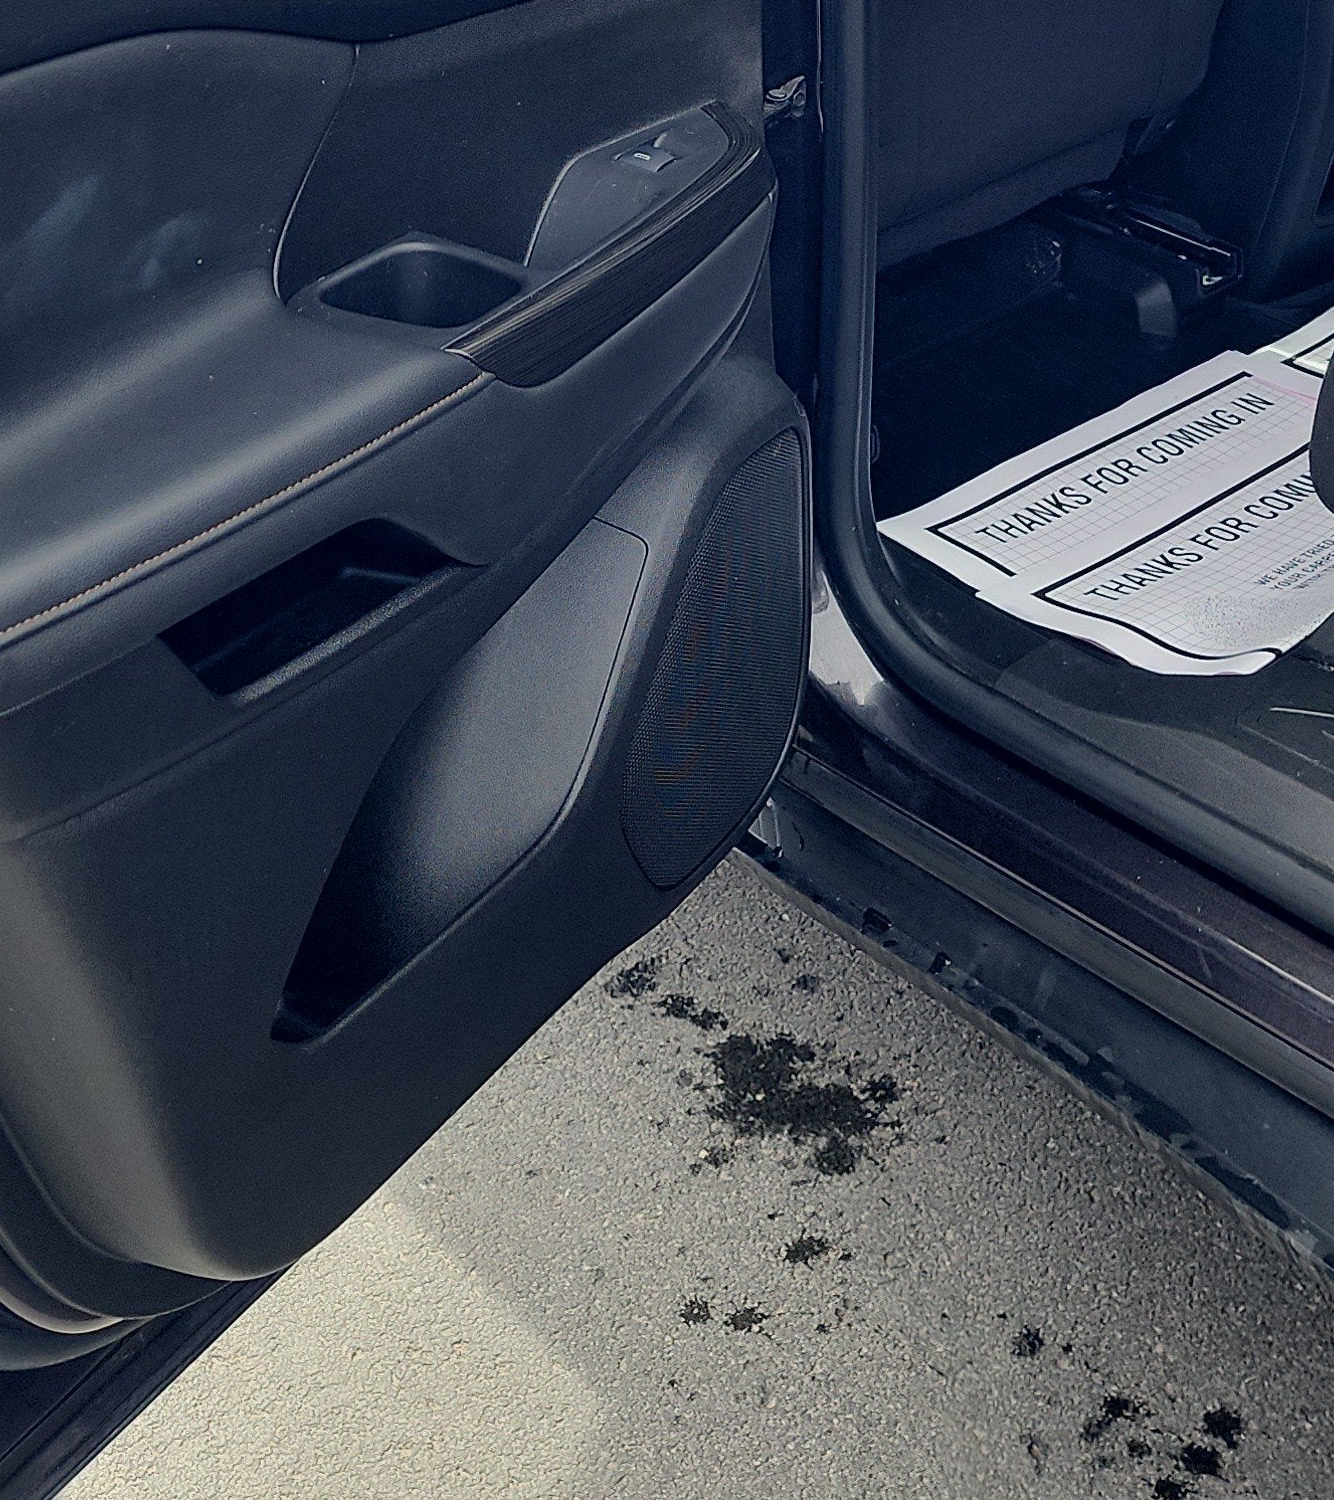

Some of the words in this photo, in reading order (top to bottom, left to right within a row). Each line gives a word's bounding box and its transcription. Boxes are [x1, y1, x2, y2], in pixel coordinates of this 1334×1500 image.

[976, 486, 1092, 544] THANKS
[1082, 456, 1148, 494] FOR
[1137, 409, 1243, 466] COMING
[1233, 392, 1274, 417] IN
[1085, 547, 1204, 601] THANKS
[1195, 515, 1261, 552] FOR
[1244, 474, 1316, 519] COMI
[1253, 573, 1279, 586] WE
[1272, 557, 1306, 576] HAVE
[1270, 572, 1306, 590] YOUR
